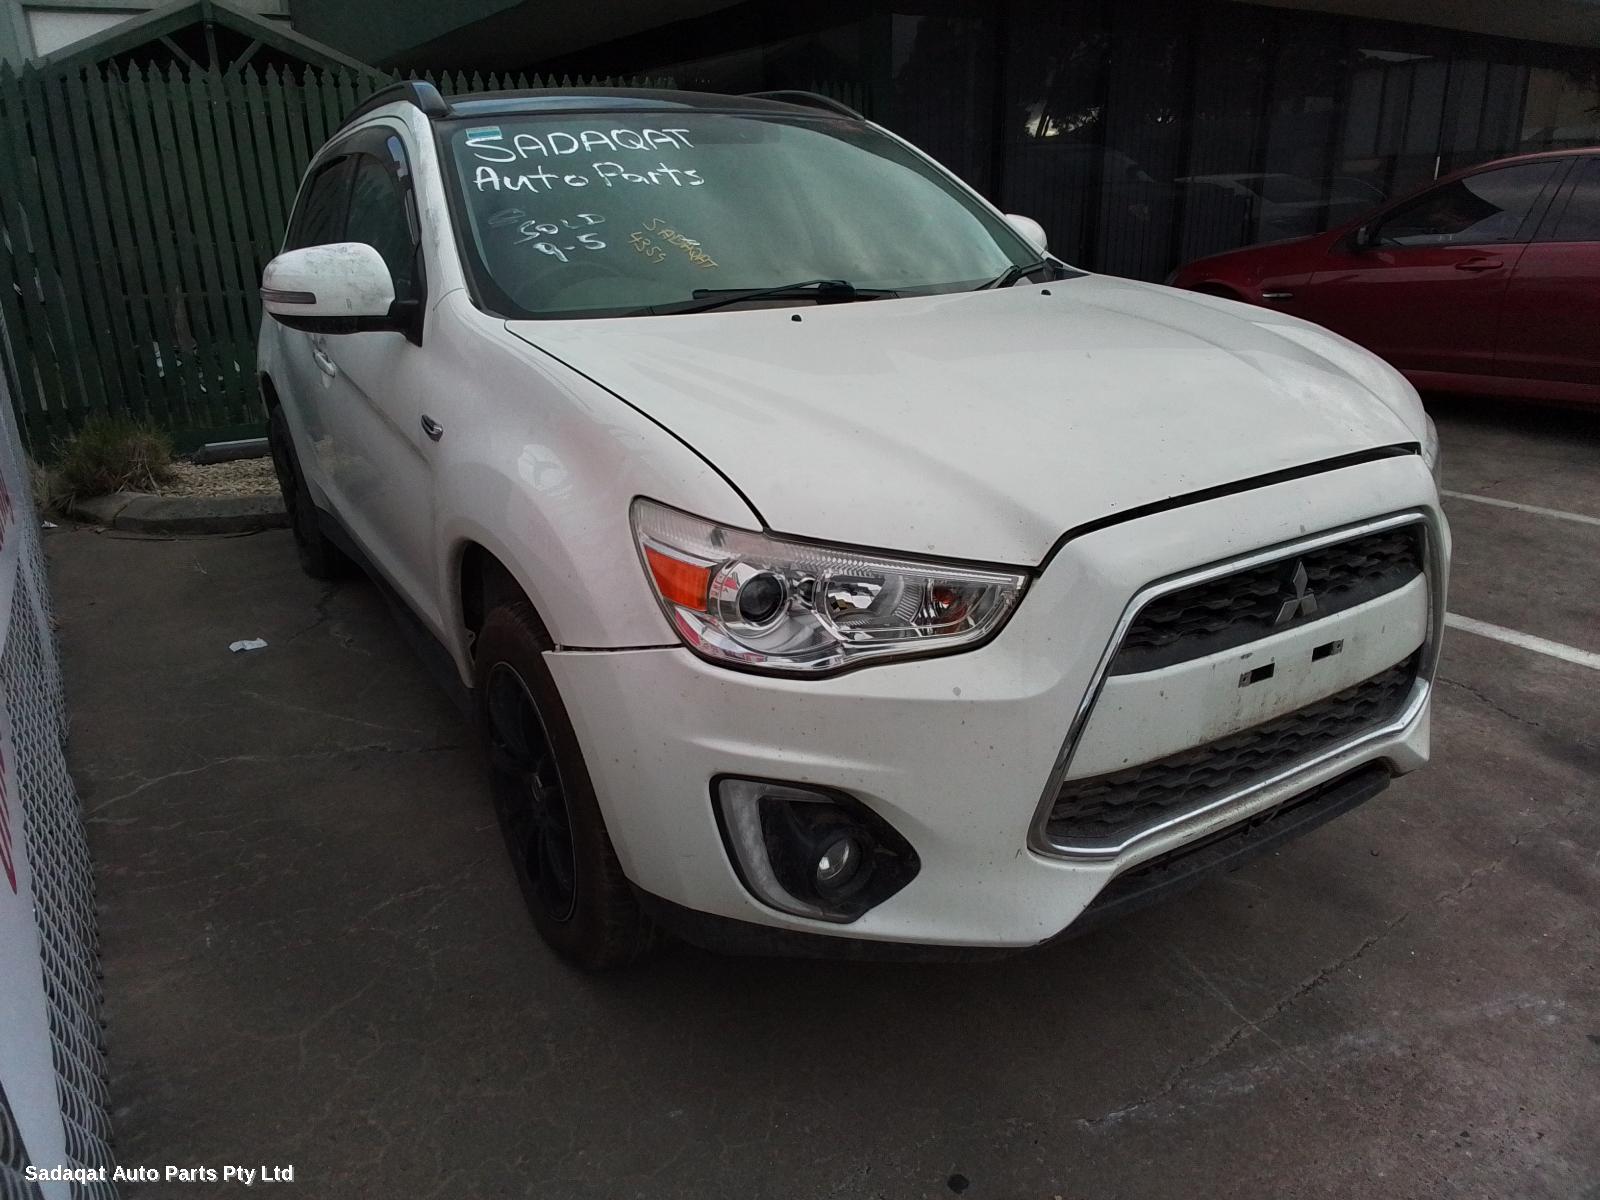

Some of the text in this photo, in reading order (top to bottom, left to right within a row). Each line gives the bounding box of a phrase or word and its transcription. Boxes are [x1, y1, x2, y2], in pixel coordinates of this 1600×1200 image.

[465, 129, 694, 163] SADAQAT
[473, 162, 704, 192] Auto Parts
